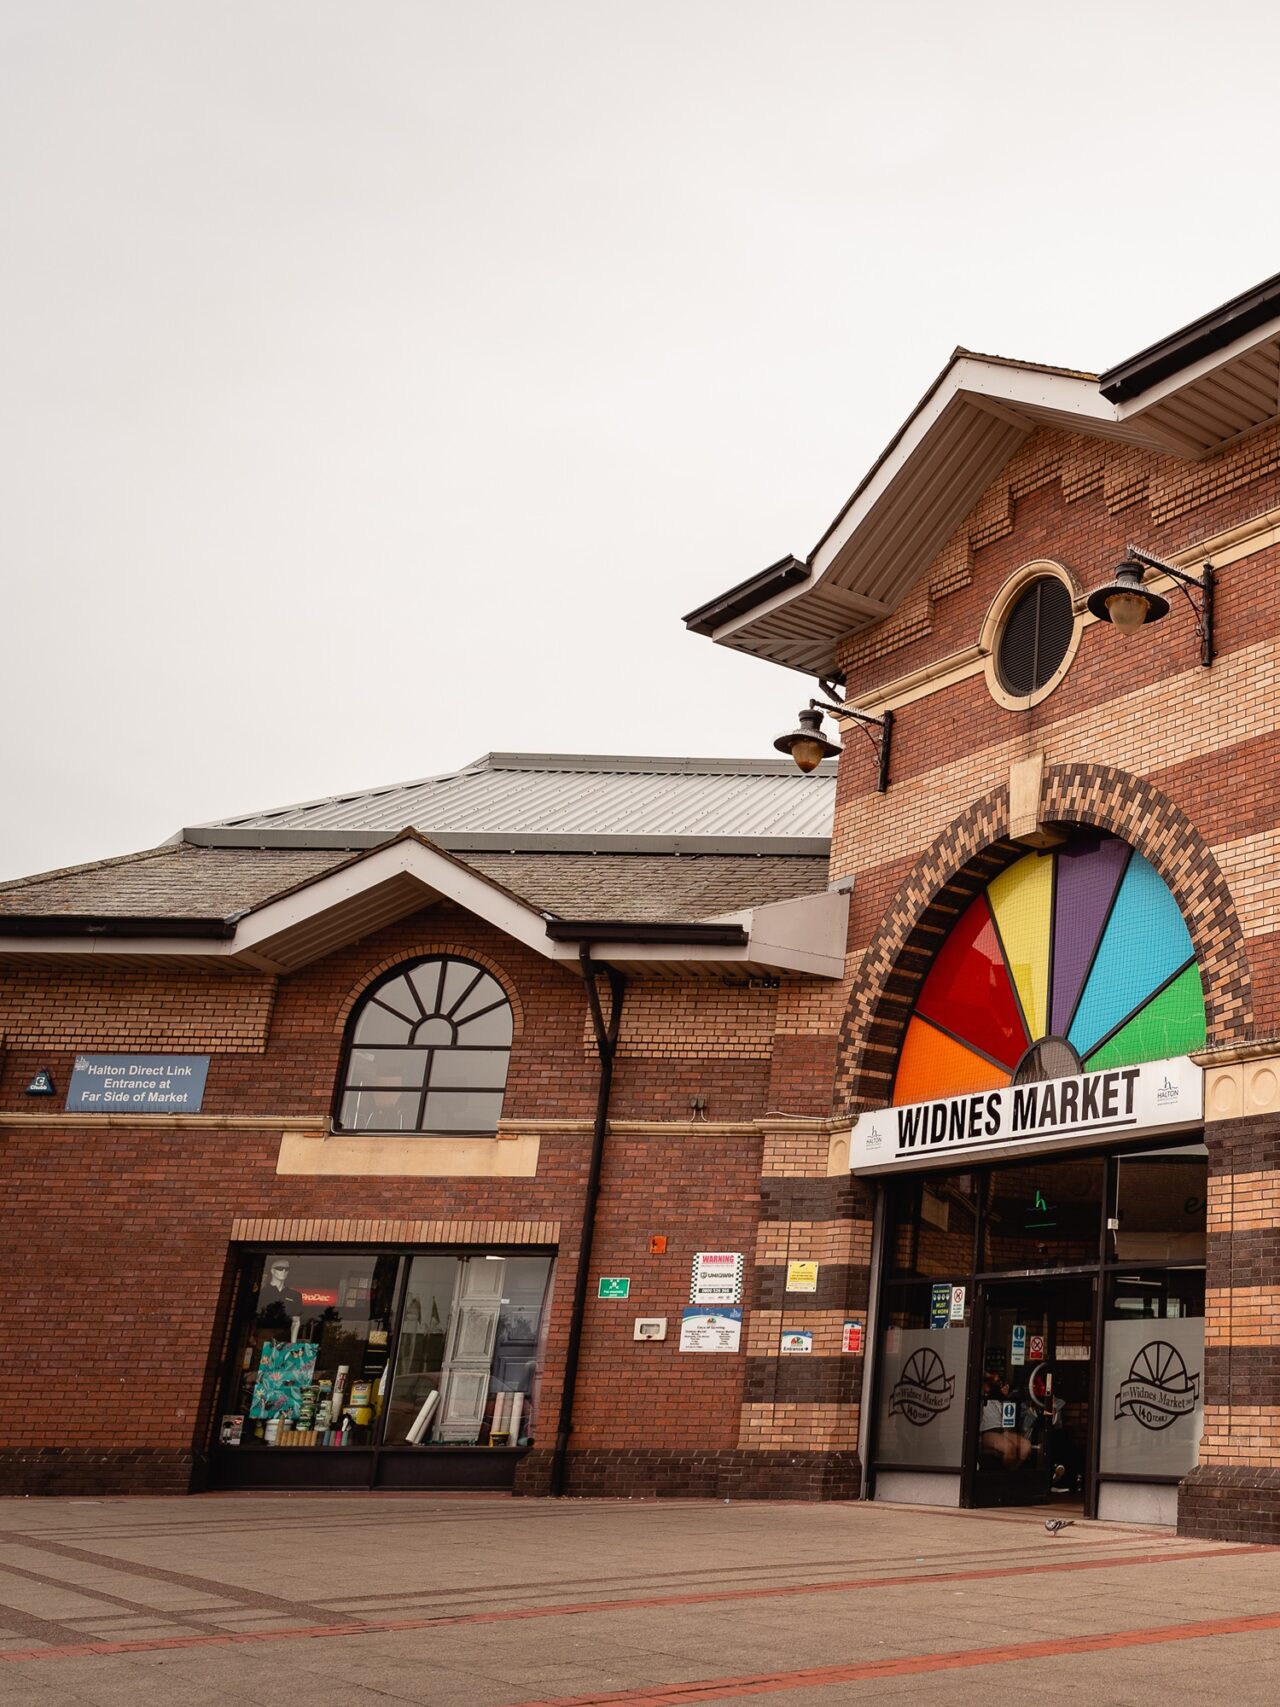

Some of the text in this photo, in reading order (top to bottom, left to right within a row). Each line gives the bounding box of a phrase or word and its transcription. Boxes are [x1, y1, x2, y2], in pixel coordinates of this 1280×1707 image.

[88, 1065, 192, 1076] Halton Direct Link
[104, 1078, 171, 1089] Entrance at
[81, 1092, 188, 1102] Far Side of Market
[1157, 1090, 1178, 1098] HALTON
[897, 1068, 1140, 1149] WIDNES MARKET
[702, 1254, 735, 1264] WARNING
[901, 1387, 943, 1406] Widnes Market
[1129, 1386, 1157, 1402] Widnes
[1158, 1392, 1185, 1409] Market
[1139, 1405, 1152, 1423] 140
